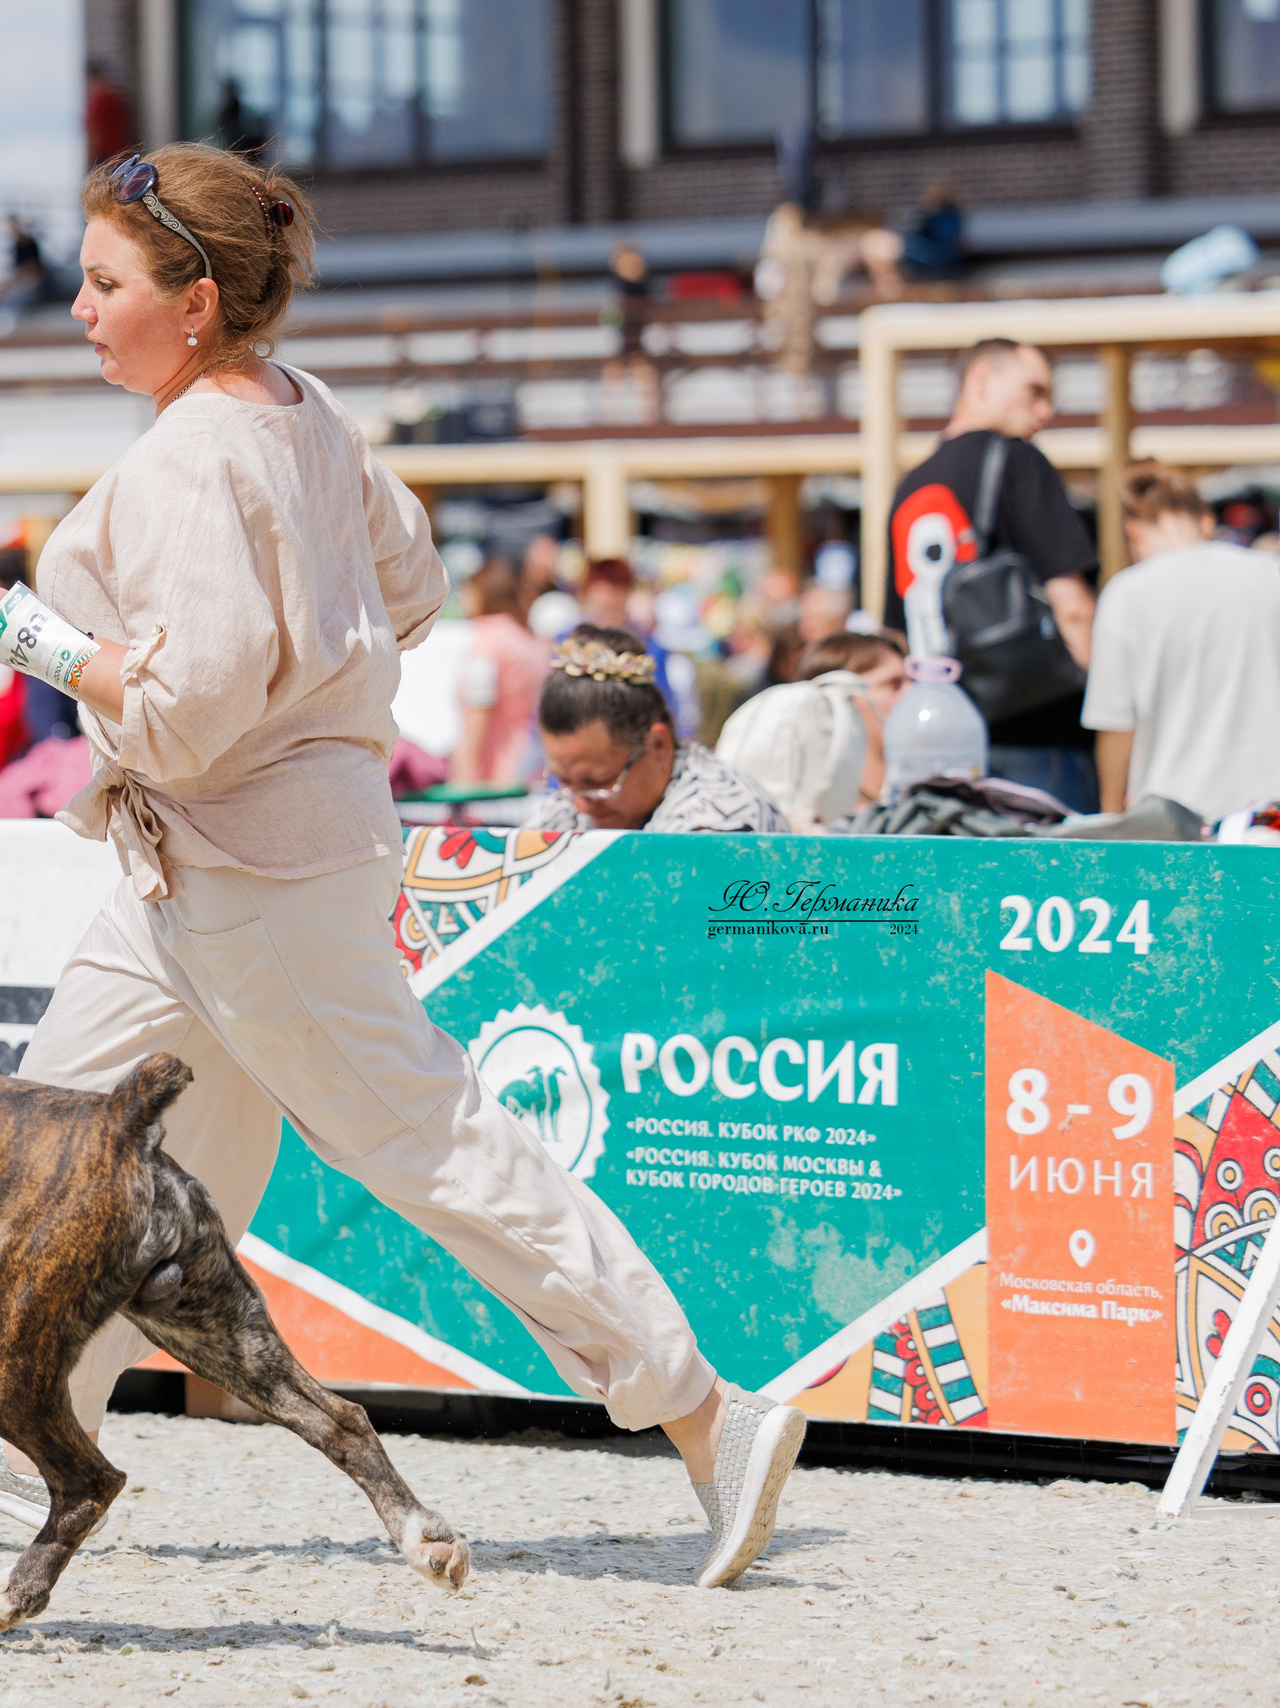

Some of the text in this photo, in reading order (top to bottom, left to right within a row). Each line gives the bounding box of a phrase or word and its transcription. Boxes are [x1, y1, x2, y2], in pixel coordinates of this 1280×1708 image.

[1000, 895, 1153, 954] 2024
[620, 1033, 898, 1106] РОССИЯ
[626, 1117, 877, 1146] «РОССИЯ. КУБОК РКФ 2024»
[626, 1147, 882, 1178] «РОССИЯ. КУБОК МОСКВЫ &
[1009, 1155, 1155, 1199] ИЮНЯ
[626, 1169, 903, 1201] КУБОК ГОРОДОВ-ГЕРОЕВ 2024»
[999, 1272, 1163, 1299] Московская область,
[1000, 1294, 1163, 1327] «Максима Парк»
